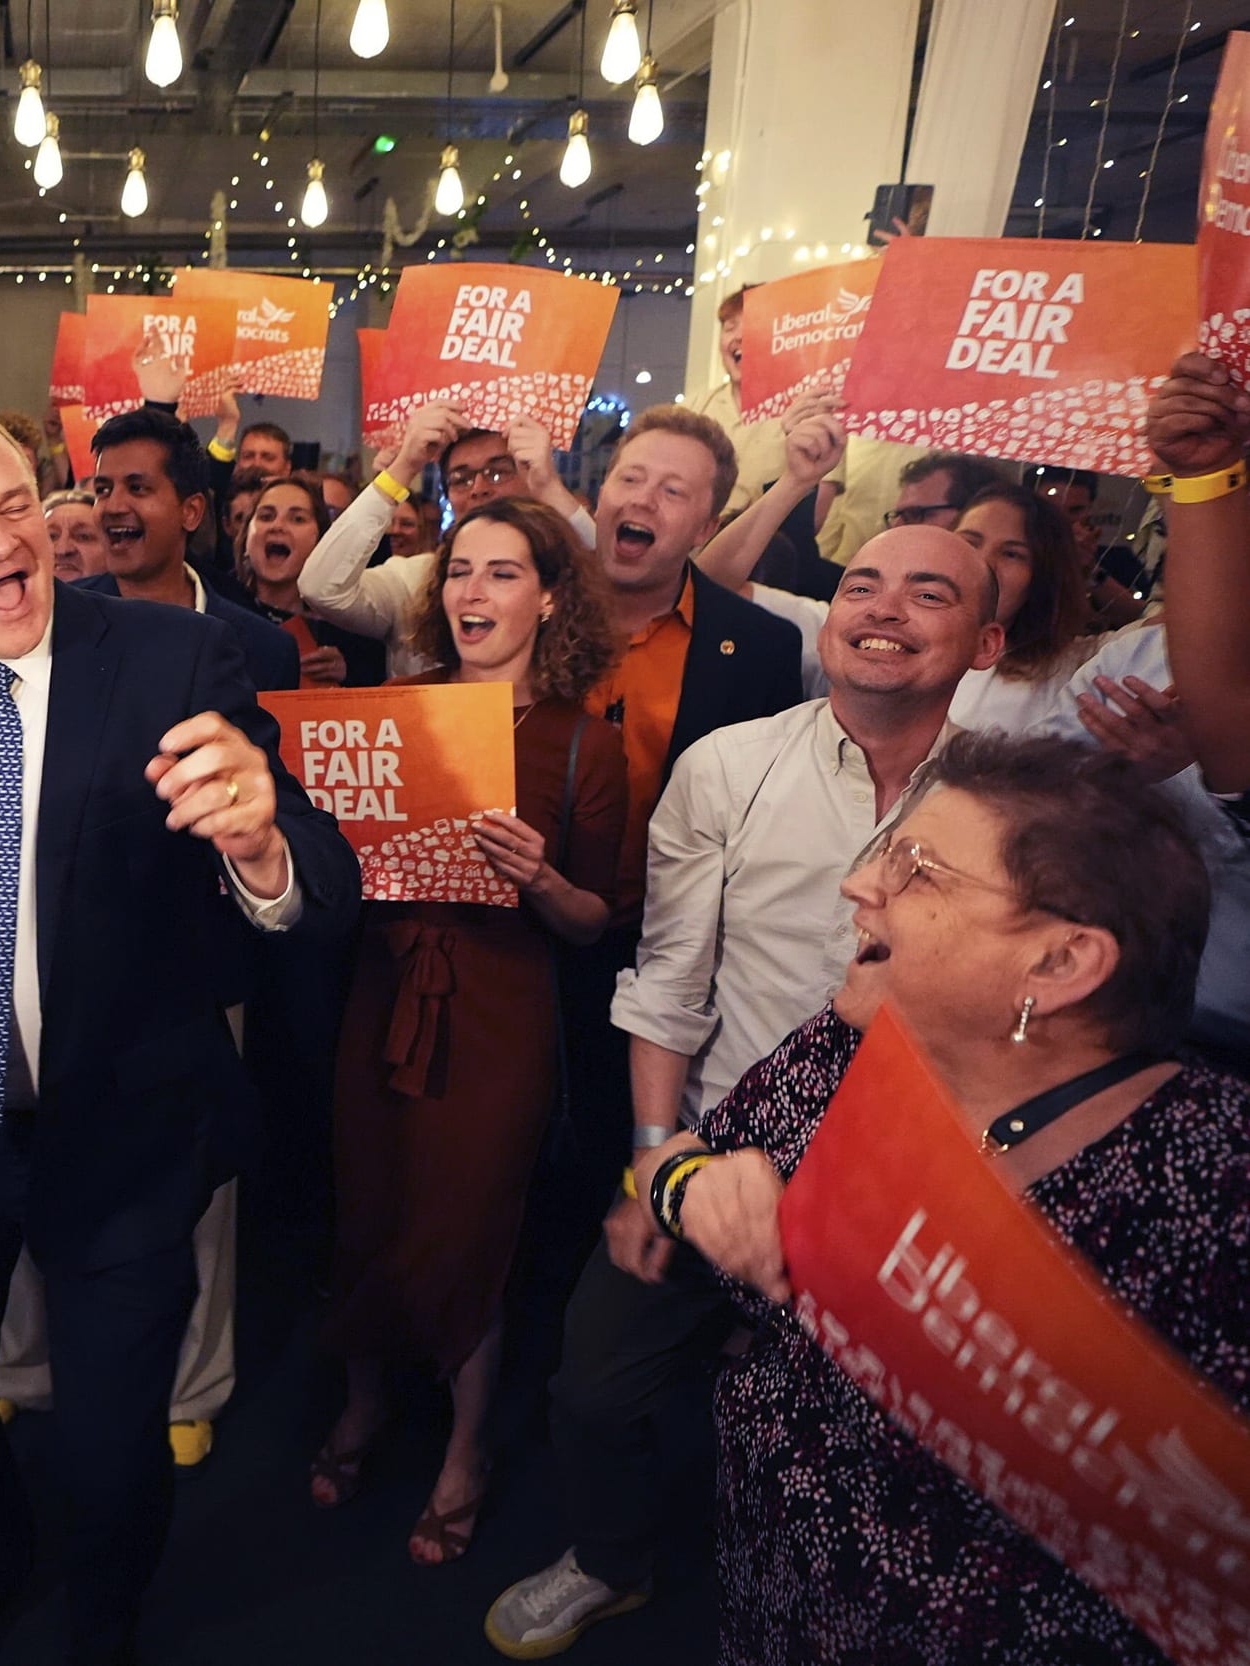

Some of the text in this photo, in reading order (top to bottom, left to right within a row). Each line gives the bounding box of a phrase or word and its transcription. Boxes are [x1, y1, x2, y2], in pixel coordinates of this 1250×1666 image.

[454, 284, 532, 314] FOR A
[969, 268, 1086, 304] FOR A
[142, 314, 198, 334] FOR A
[446, 307, 526, 343] FAIR
[772, 302, 832, 336] Liberal
[956, 299, 1075, 344] FAIR
[438, 335, 518, 369] DEAL
[944, 336, 1060, 379] DEAL
[300, 718, 403, 749] FOR A
[303, 750, 404, 787] FAIR
[307, 788, 408, 822] DEAL
